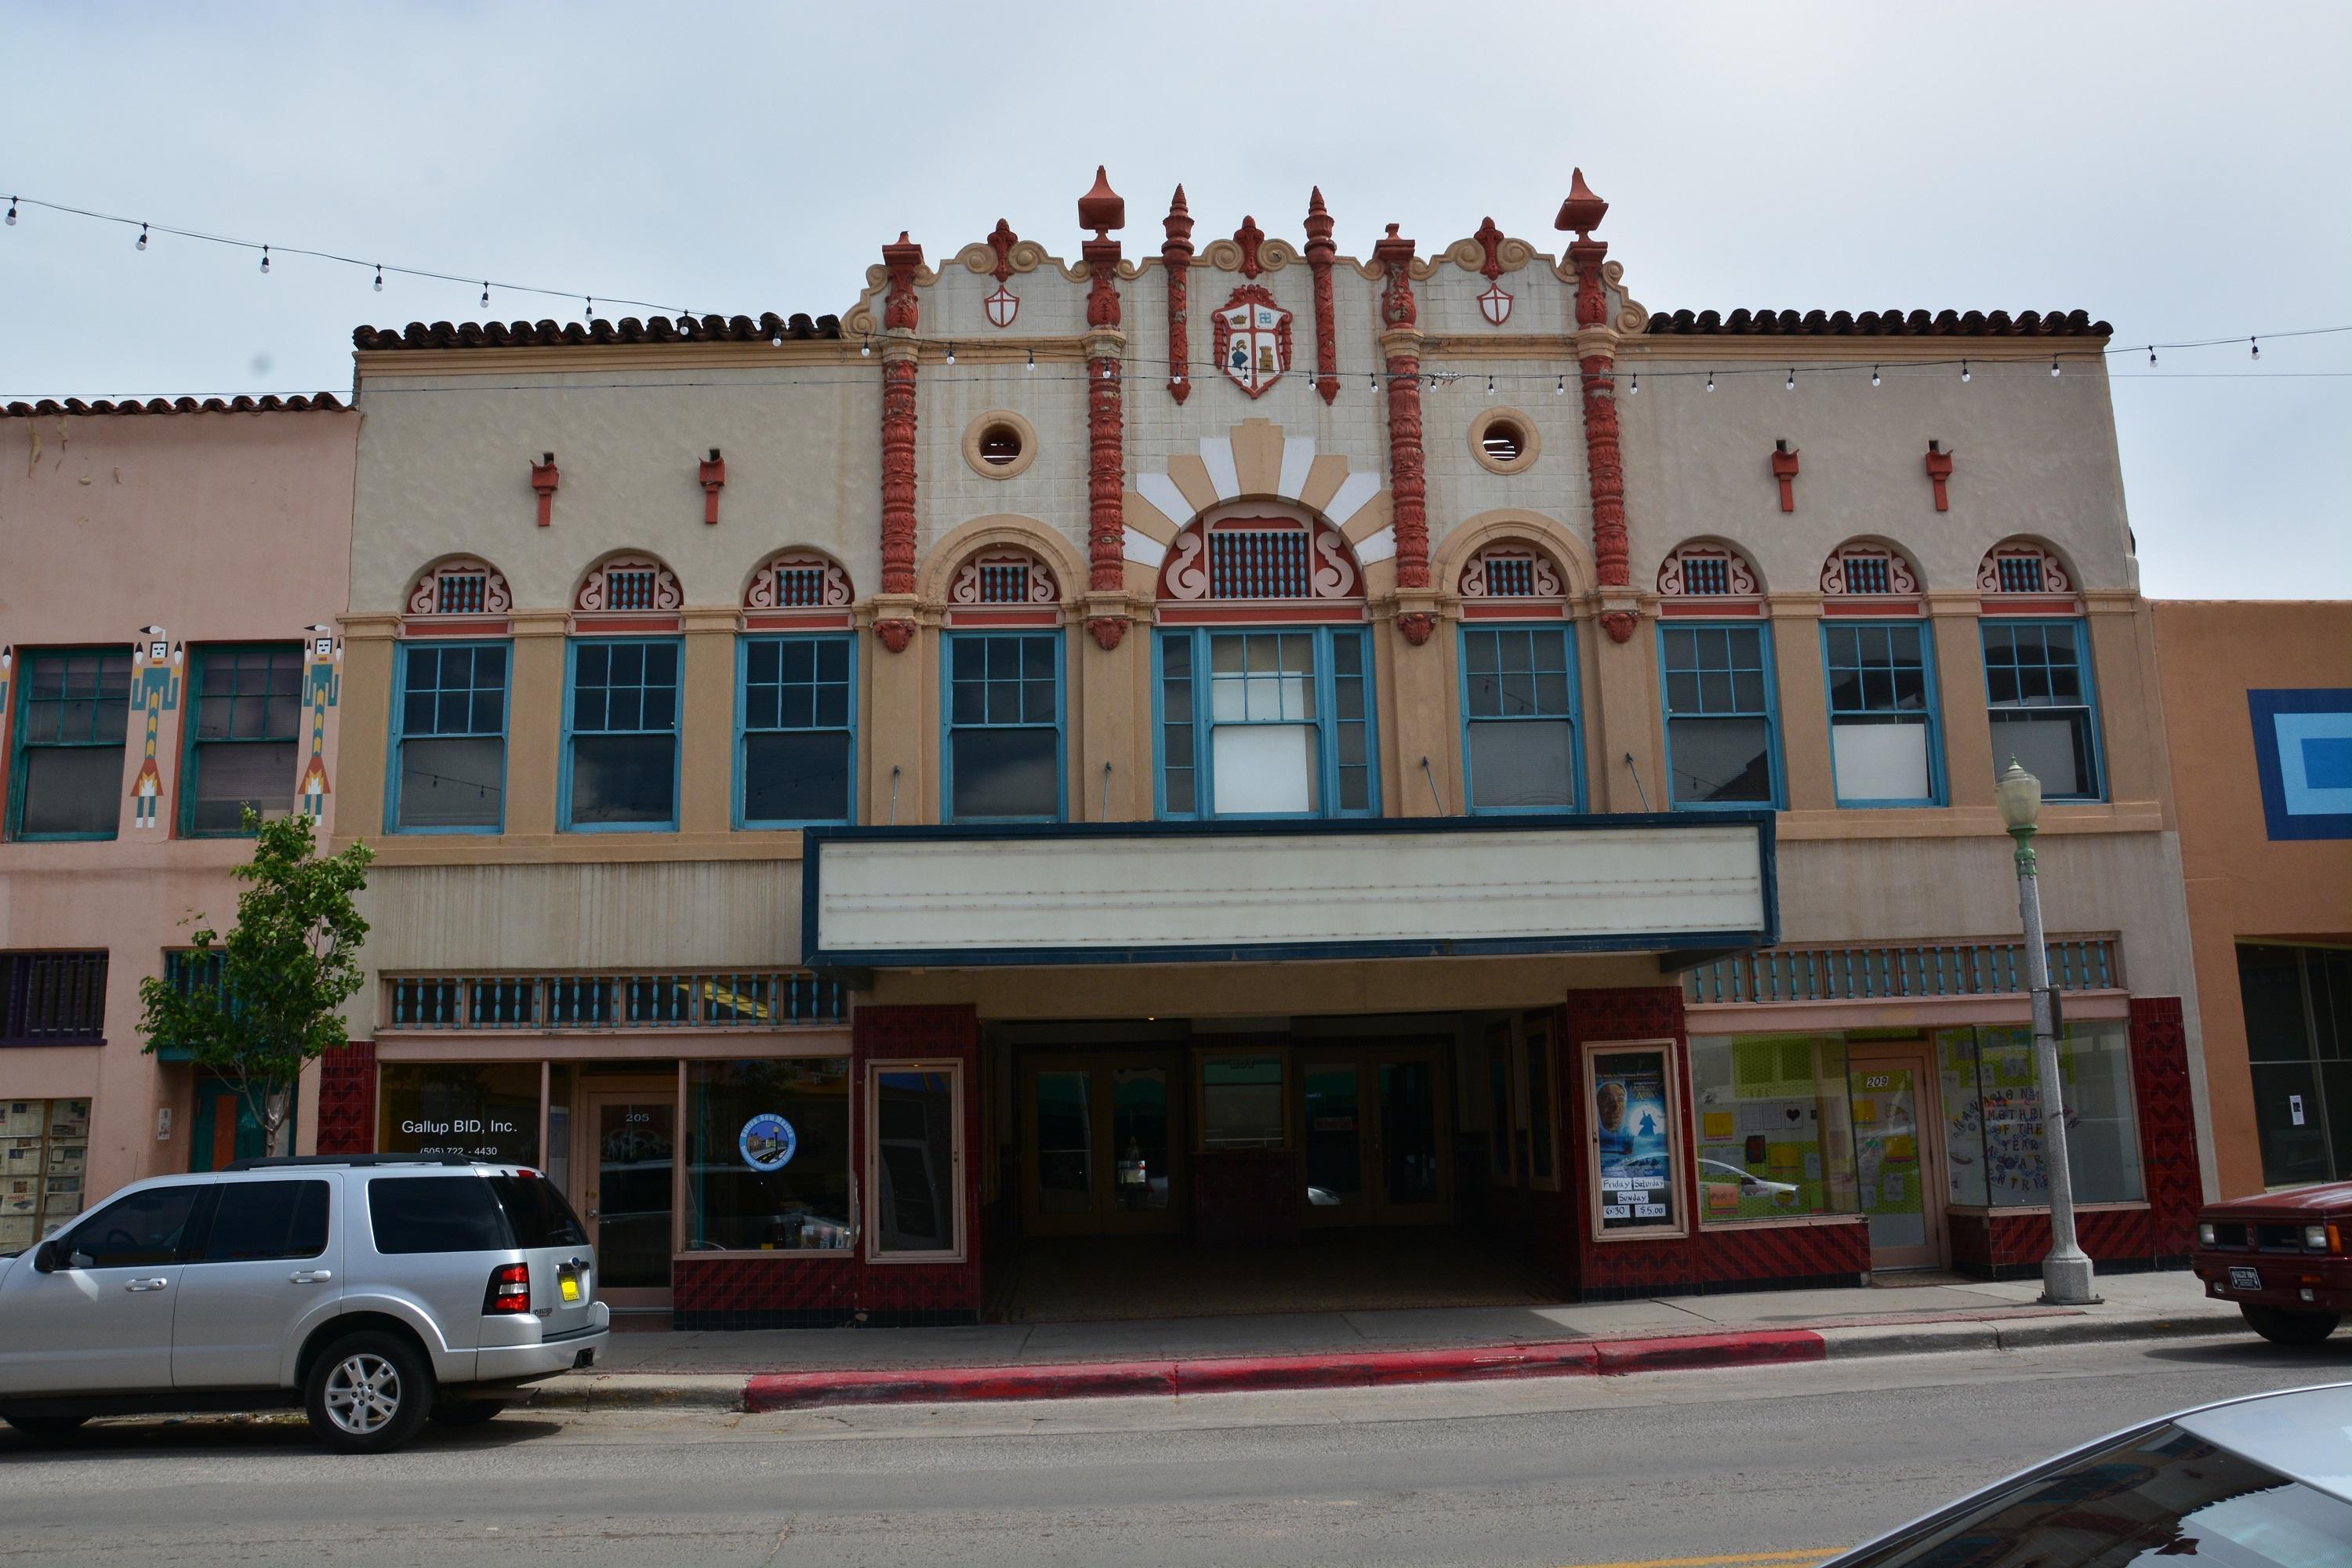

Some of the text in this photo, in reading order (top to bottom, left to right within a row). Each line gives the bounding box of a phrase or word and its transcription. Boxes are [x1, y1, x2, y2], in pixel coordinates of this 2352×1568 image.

[1867, 1076, 1888, 1087] 209
[626, 1113, 650, 1123] 205
[1987, 1108, 2043, 1122] MOTHE
[401, 1120, 517, 1135] Gallup BID, Inc.
[2017, 1123, 2043, 1135] THE
[447, 1147, 464, 1156] 722
[474, 1147, 498, 1156] 4430
[2001, 1140, 2039, 1152] YEAR
[1603, 1178, 1664, 1189] Friday Saturday
[1605, 1207, 1625, 1216] 6:30
